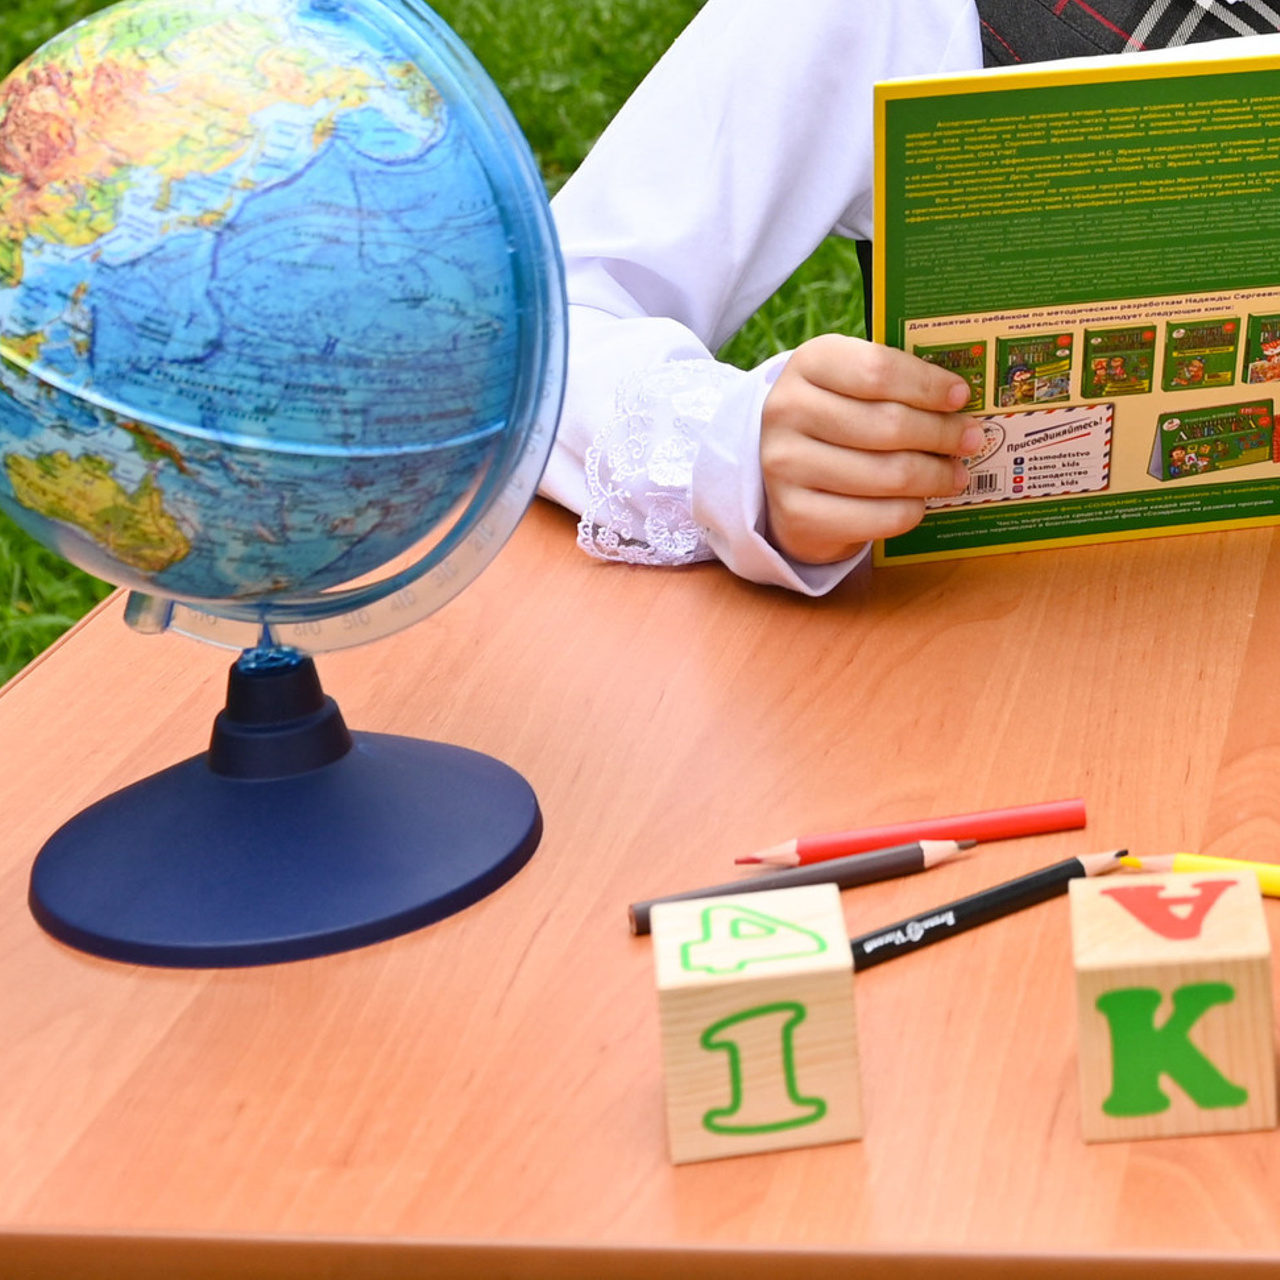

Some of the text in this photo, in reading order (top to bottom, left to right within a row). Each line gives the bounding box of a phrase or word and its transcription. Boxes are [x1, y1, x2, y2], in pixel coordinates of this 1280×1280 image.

[931, 317, 971, 328] занятий
[1046, 304, 1118, 317] методическим
[1119, 298, 1183, 311] разработкам
[1184, 294, 1232, 305] Надежды
[1007, 318, 1076, 330] издательство
[1078, 312, 1142, 324] рекомендует
[1144, 306, 1202, 318] следующие
[1006, 417, 1103, 453] Присоединяйтесь!
[680, 905, 827, 974] 4
[700, 1001, 827, 1135] 1
[1095, 982, 1249, 1117] К
